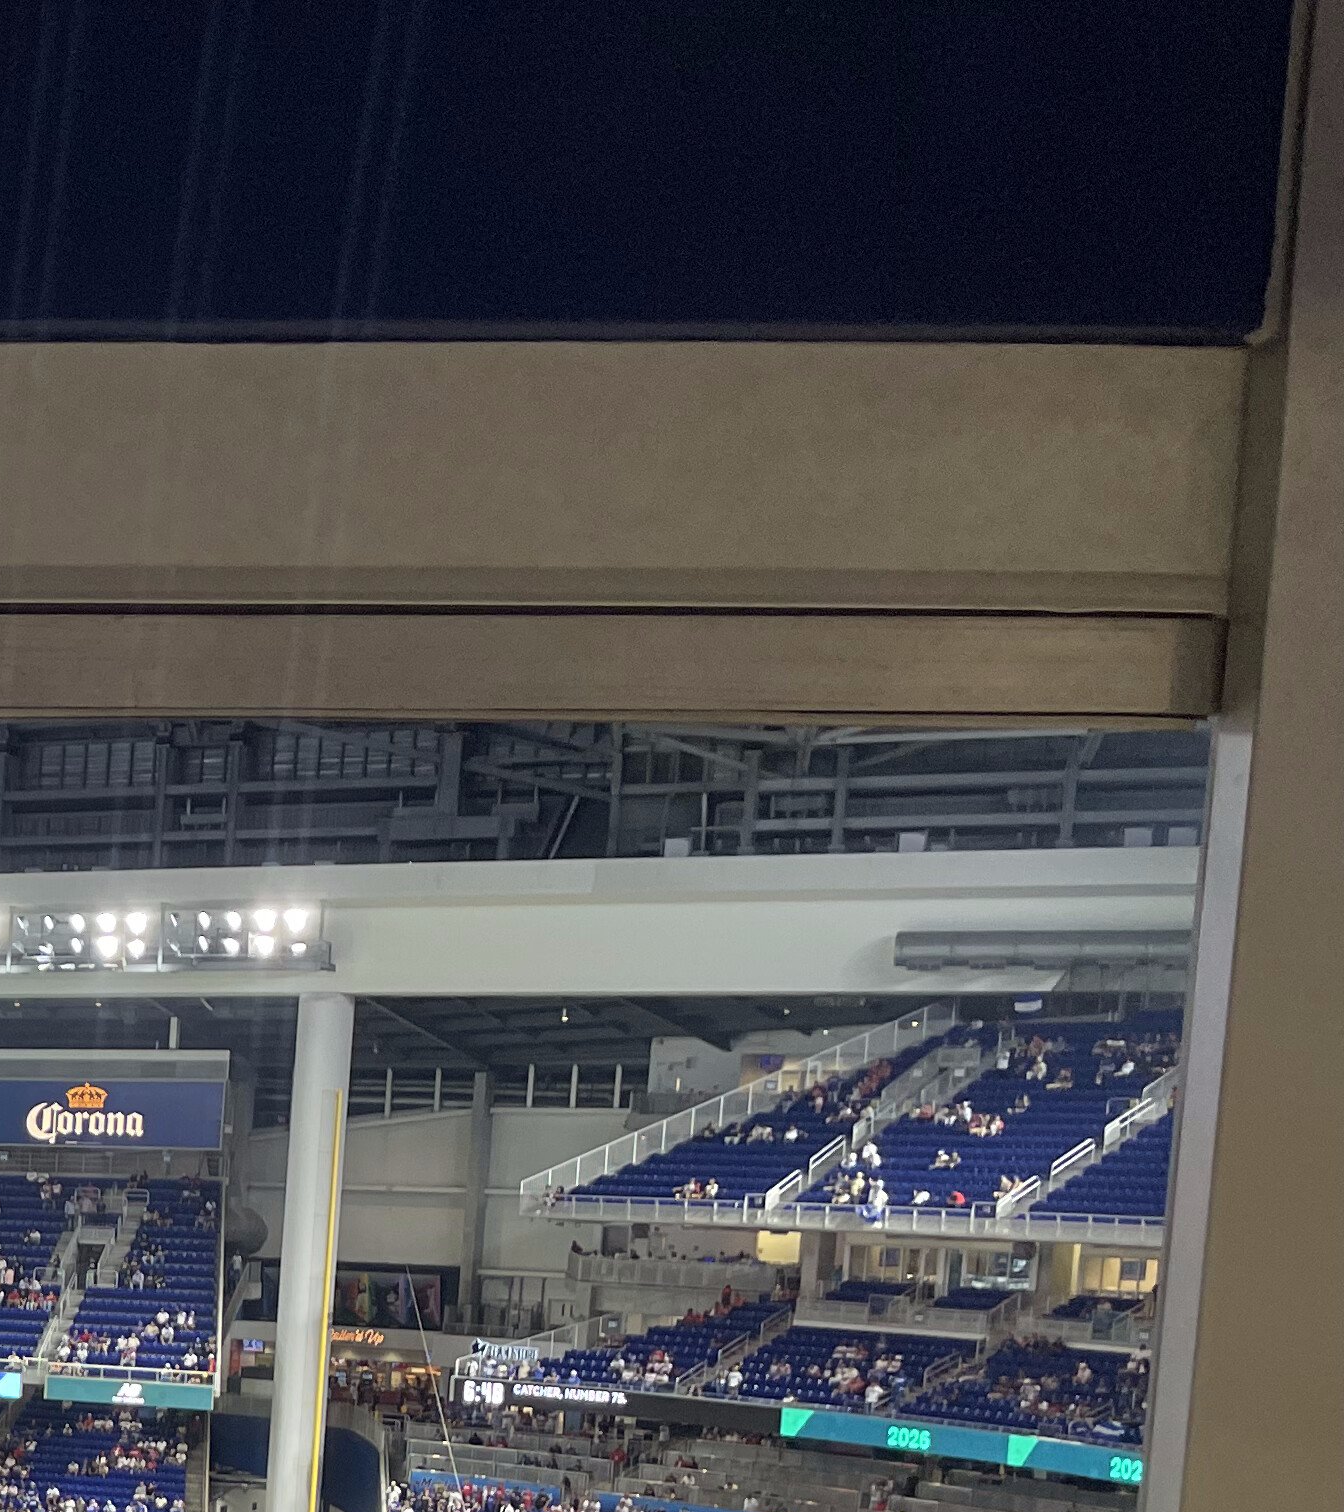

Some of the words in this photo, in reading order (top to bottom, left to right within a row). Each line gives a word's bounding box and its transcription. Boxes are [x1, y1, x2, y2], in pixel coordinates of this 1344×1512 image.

[26, 1101, 144, 1144] Corona
[887, 1426, 931, 1450] 2026
[1110, 1457, 1143, 1482] 202
